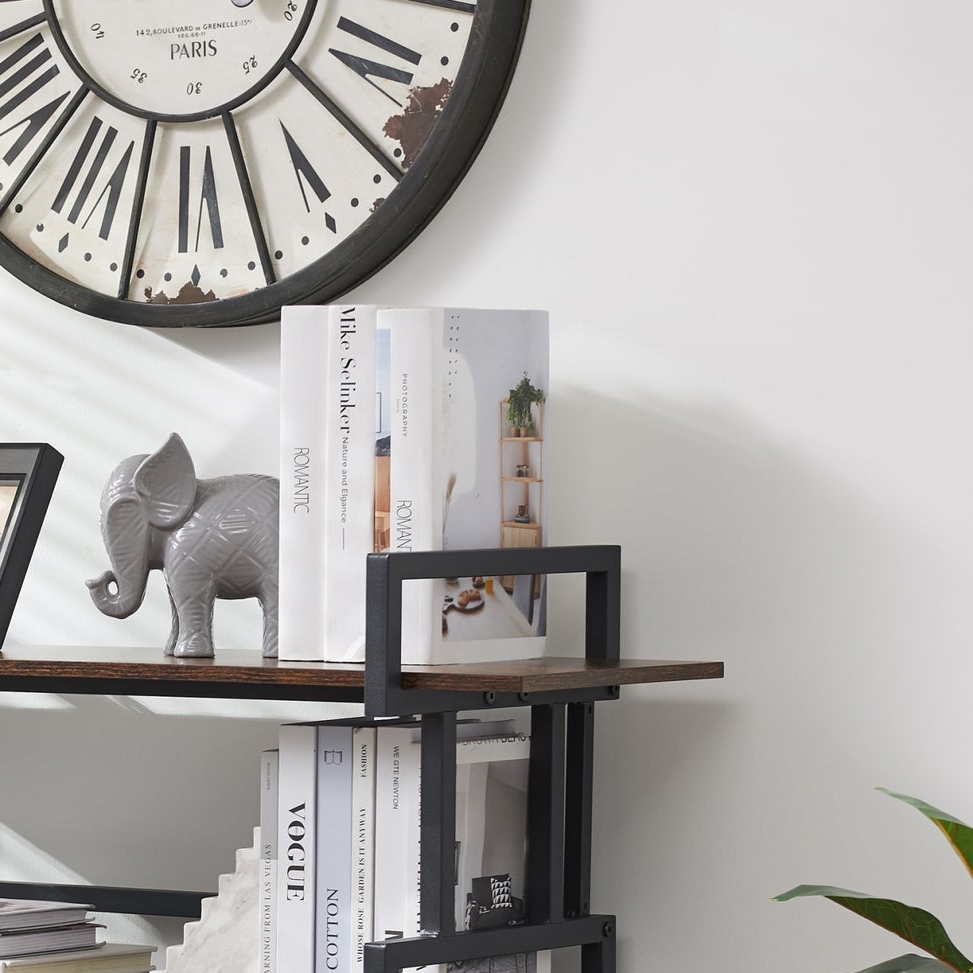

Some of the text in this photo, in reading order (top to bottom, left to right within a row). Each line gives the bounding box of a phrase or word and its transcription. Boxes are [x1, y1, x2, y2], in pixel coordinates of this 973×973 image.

[90, 22, 105, 40] 40
[170, 39, 218, 60] PARIS
[242, 55, 259, 74] 25
[130, 68, 148, 85] 35
[186, 81, 203, 96] 30
[340, 357, 356, 434] Selinker
[341, 436, 349, 468] Nature
[293, 447, 310, 514] ROMANTIC
[360, 743, 368, 778] FASHION
[393, 745, 400, 758] WE
[287, 801, 306, 901] VOGUE
[358, 857, 365, 866] IS
[325, 887, 339, 971] COTTON
